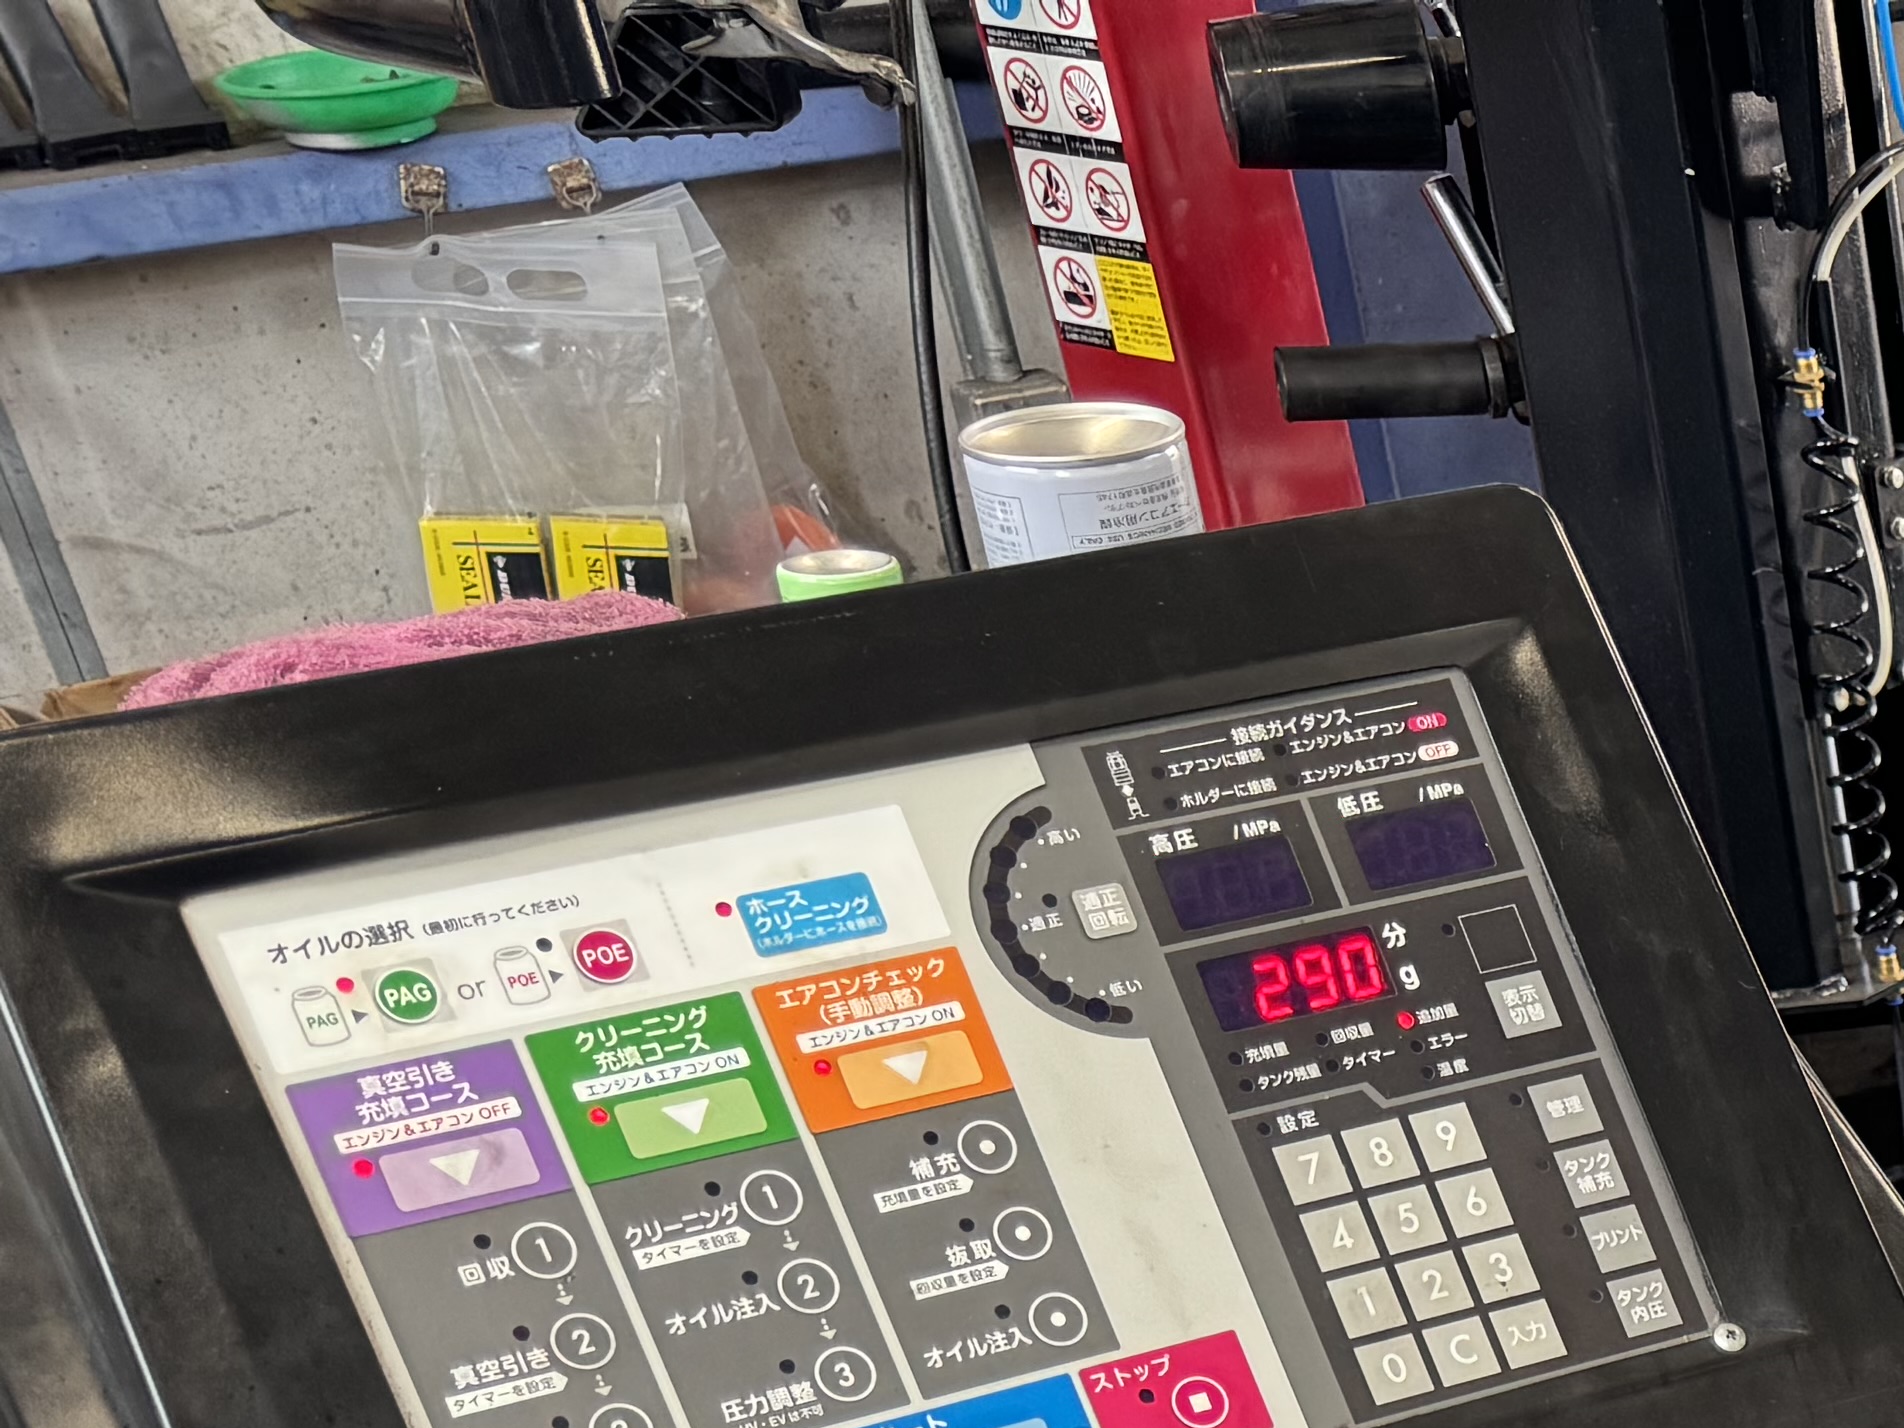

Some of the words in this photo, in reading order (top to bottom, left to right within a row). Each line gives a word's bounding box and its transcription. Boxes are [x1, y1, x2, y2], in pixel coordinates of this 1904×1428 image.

[1230, 708, 1352, 746] 接続ガイダンス
[1166, 748, 1266, 778] エアコンに接続
[1425, 744, 1454, 757] OFF
[1338, 791, 1384, 818] 低圧
[1046, 826, 1082, 847] 高い
[1149, 828, 1198, 856] 高圧
[746, 891, 809, 915] ホース
[1080, 889, 1122, 911] 適正
[754, 896, 871, 935] クリーニング
[1028, 912, 1064, 932] 適正
[1088, 906, 1130, 931] 回転
[267, 919, 414, 965] オイルの選択
[1382, 922, 1408, 950] 分
[581, 942, 630, 969] POE
[458, 980, 487, 1001] or
[507, 971, 539, 989] POE
[775, 956, 947, 1008] エアコンチェック
[1108, 978, 1144, 999] 低い
[1252, 932, 1386, 1025] 290
[1399, 964, 1420, 990] g
[383, 981, 432, 1009] PAG
[1502, 982, 1540, 1008] 表示
[306, 1012, 339, 1030] PAG
[931, 1005, 956, 1022] ON
[1508, 1002, 1546, 1026] 切替
[576, 1005, 709, 1053] クリーニング
[1428, 1032, 1469, 1052] エラー
[593, 1031, 711, 1075] 充填コース
[715, 1053, 740, 1070] ON
[1341, 1048, 1396, 1071] タイマー
[357, 1060, 456, 1098] 真空引き
[355, 1081, 480, 1126] 充填コース
[479, 1102, 512, 1121] OFF
[1546, 1096, 1585, 1118] 管理
[1277, 1110, 1320, 1134] 設定
[1435, 1120, 1458, 1152] 9
[1368, 1136, 1394, 1168] 8
[1564, 1151, 1612, 1177] タンク
[908, 1153, 962, 1181] 補充
[1298, 1150, 1321, 1185] 7
[1576, 1170, 1616, 1193] 補充
[1465, 1184, 1489, 1218] 6
[625, 1201, 740, 1247] クリーニング
[1397, 1201, 1421, 1234] 5
[1332, 1216, 1355, 1251] 4
[1591, 1224, 1643, 1252] プリント
[945, 1238, 997, 1267] 抜取
[457, 1255, 516, 1287] 回収
[1489, 1252, 1515, 1284] 3
[1421, 1268, 1449, 1302] 2
[1617, 1280, 1664, 1307] タンク
[664, 1292, 781, 1336] オイル注入
[1357, 1284, 1377, 1317] 1
[1630, 1301, 1668, 1324] 内圧
[1506, 1321, 1548, 1346] 入力
[923, 1327, 1033, 1370] オイル注入
[1449, 1333, 1479, 1365] C
[450, 1347, 551, 1390] 真空引き
[1090, 1354, 1172, 1394] ストップ
[1381, 1351, 1408, 1383] 0
[721, 1381, 818, 1424] 圧力調整
